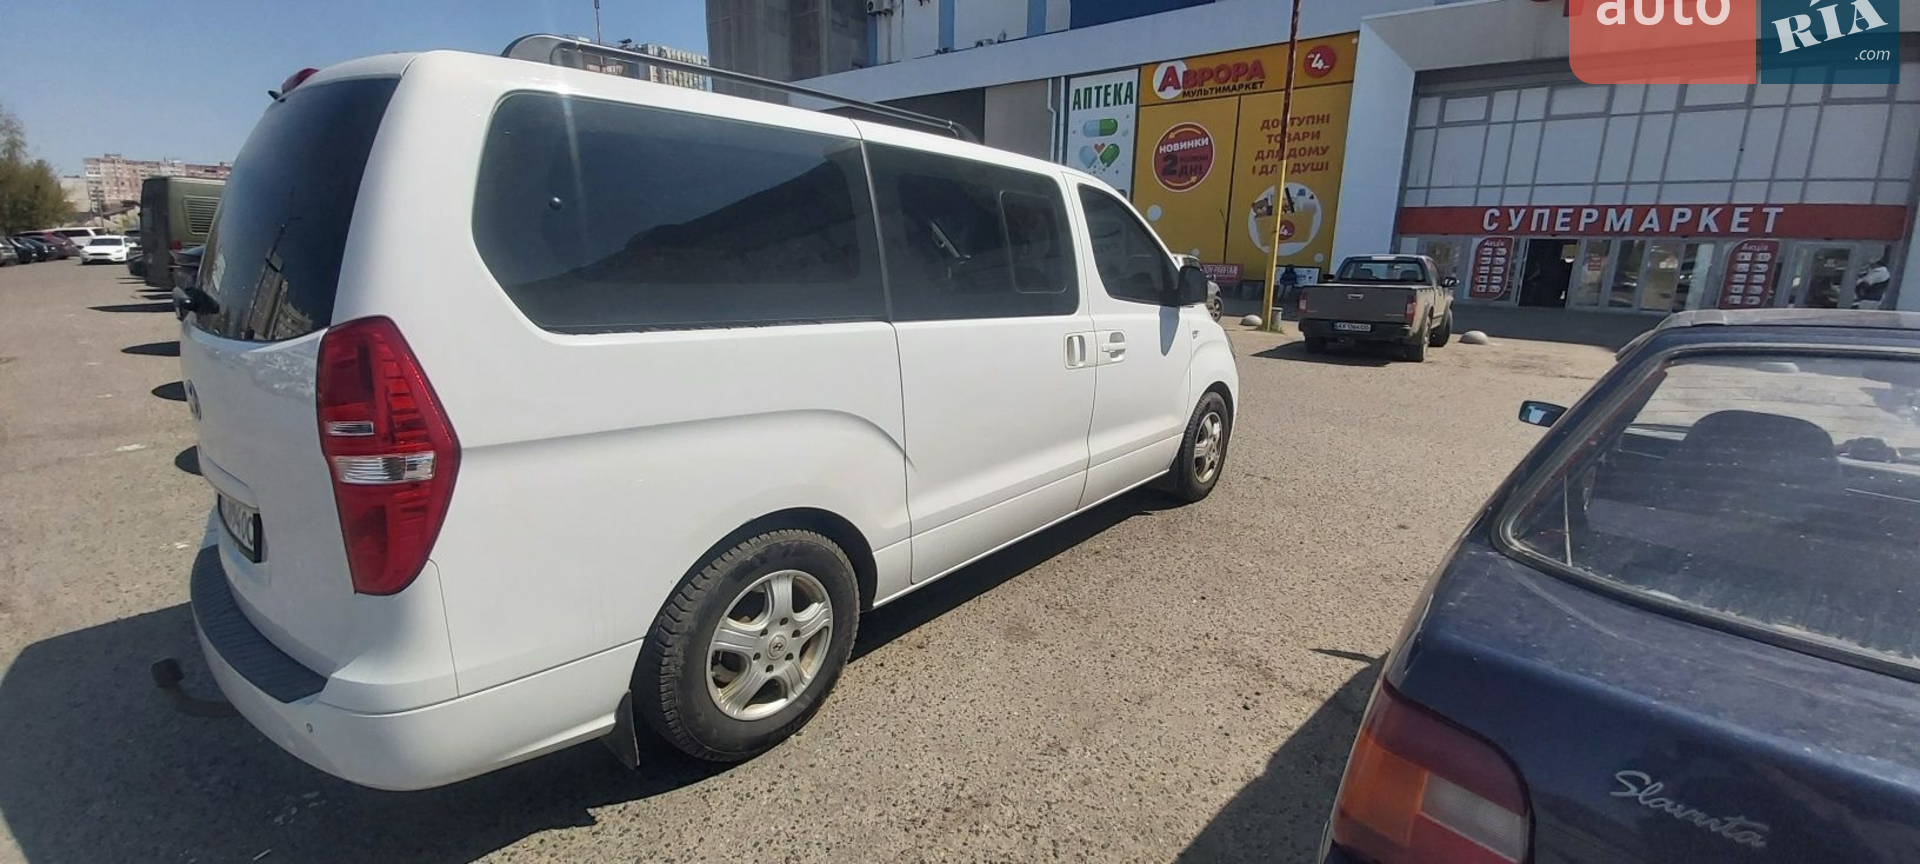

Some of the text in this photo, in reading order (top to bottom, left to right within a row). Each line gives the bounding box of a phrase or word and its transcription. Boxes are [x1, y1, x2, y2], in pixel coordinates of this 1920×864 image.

[1158, 60, 1266, 92] АВРОРА
[1072, 81, 1134, 111] АПТЕКА
[1182, 80, 1265, 98] МУЛЬТИМАРКЕТ
[1260, 114, 1330, 131] ДОТУПНІ
[1159, 137, 1209, 154] НОВИНКИ
[1287, 145, 1330, 159] ДОМУ
[1162, 154, 1178, 176] 2
[1291, 161, 1329, 175] ДУШІ
[1483, 207, 1785, 233] СУПЕРМАРКЕТ
